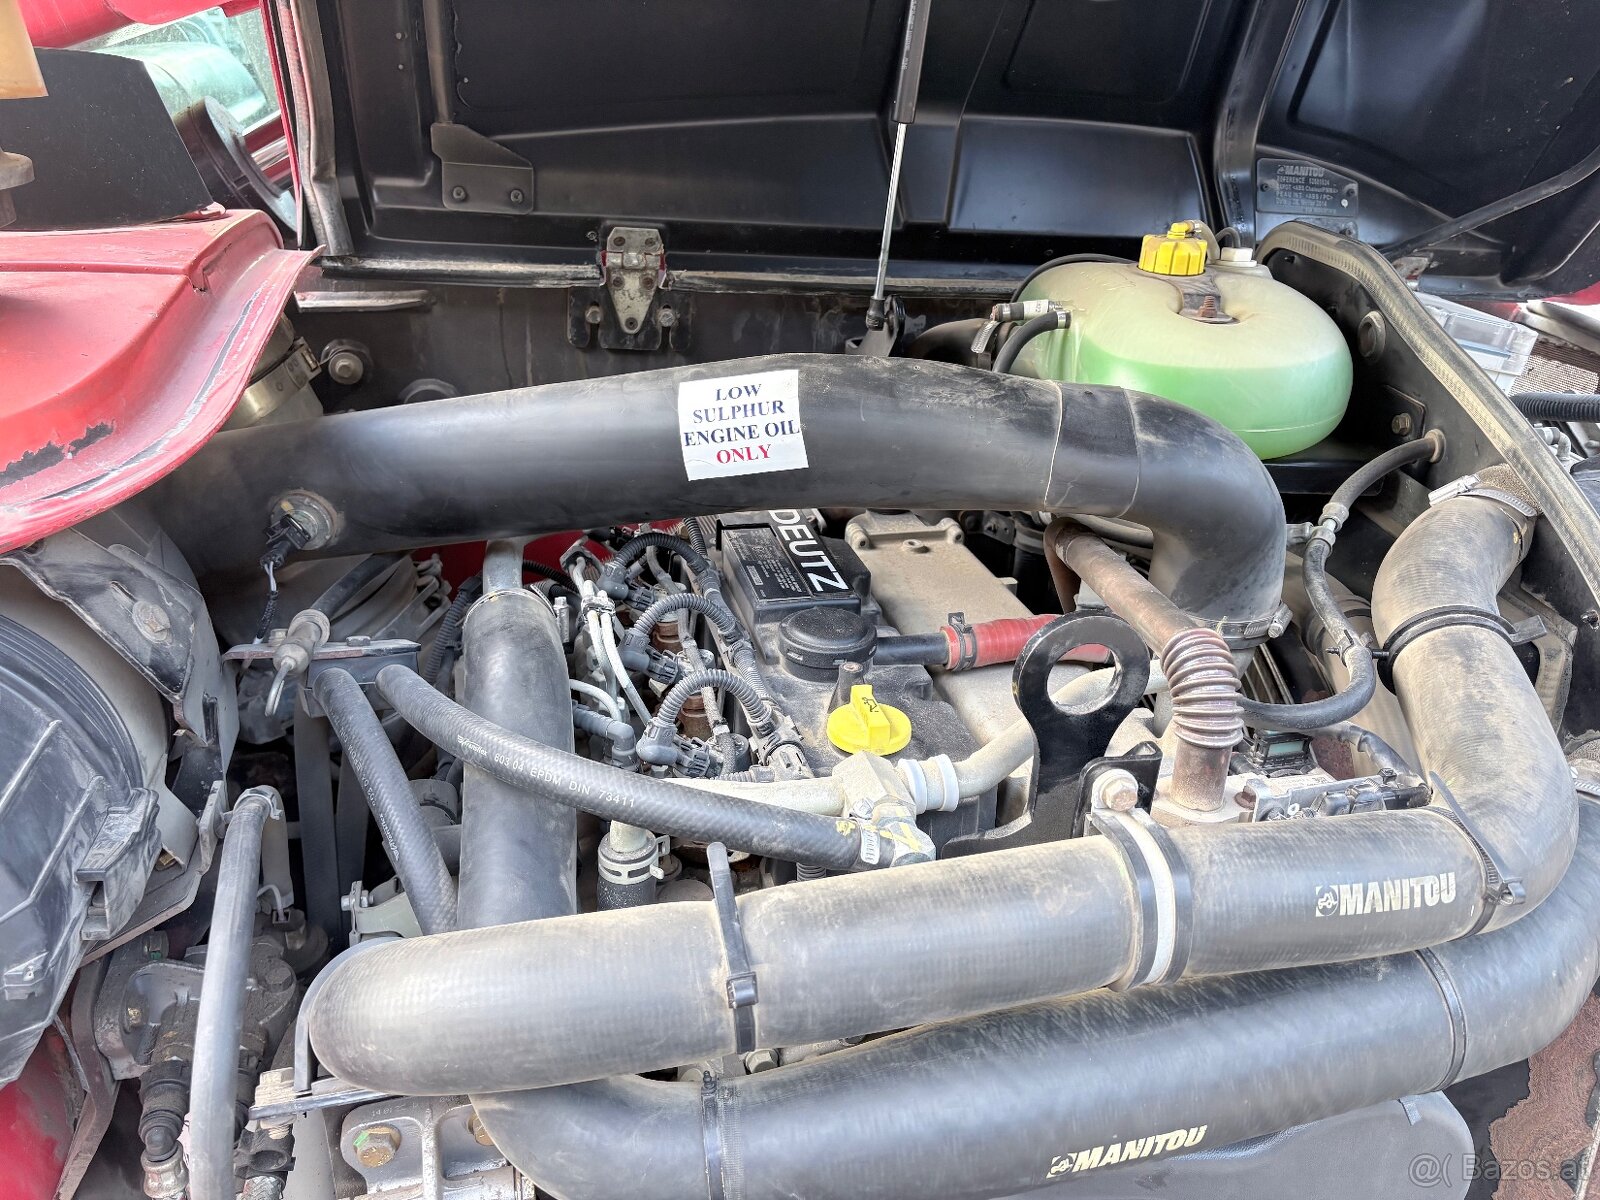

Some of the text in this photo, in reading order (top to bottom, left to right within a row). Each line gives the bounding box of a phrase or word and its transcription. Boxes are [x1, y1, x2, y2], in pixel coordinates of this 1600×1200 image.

[1285, 165, 1325, 178] MANITOU
[715, 384, 762, 401] LOW
[693, 400, 786, 424] SULPHUR
[683, 420, 801, 447] ENGINE OIL
[716, 444, 771, 464] ONLY
[767, 509, 849, 592] DEUTZ
[512, 761, 525, 772] 04
[530, 766, 563, 786] EPDM
[569, 781, 591, 796] DIN
[598, 789, 635, 808] 73411
[1339, 871, 1457, 916] MANITOU
[1072, 1124, 1208, 1173] MANITOU
